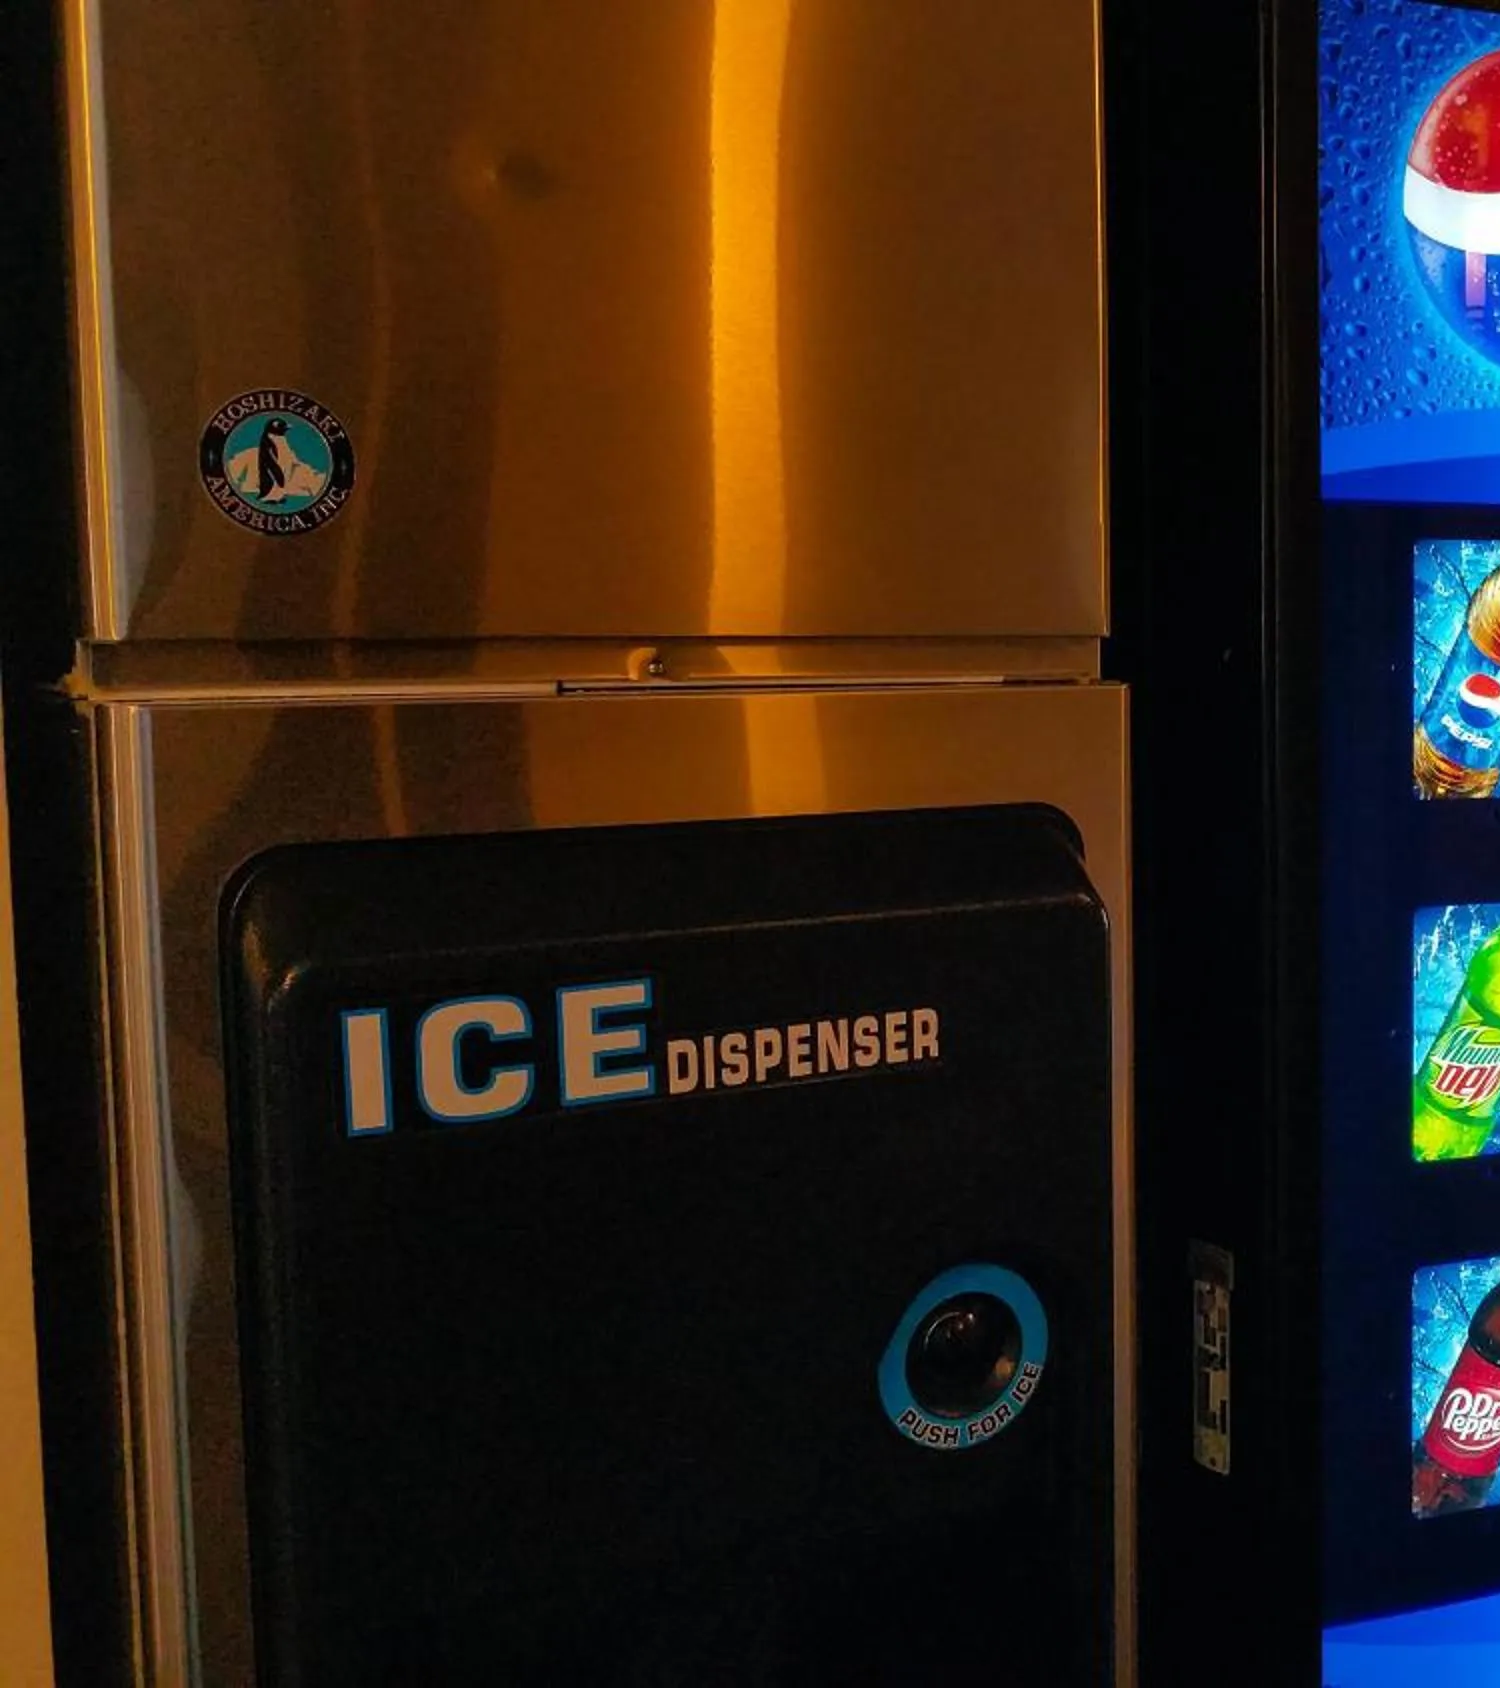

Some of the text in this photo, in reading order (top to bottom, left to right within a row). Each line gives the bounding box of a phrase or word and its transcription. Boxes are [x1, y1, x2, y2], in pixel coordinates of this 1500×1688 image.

[213, 392, 346, 443] HOSHIZAKI
[340, 977, 939, 1137] ICE DISPENSER
[897, 1361, 1043, 1446] PUSH FOR ICE
